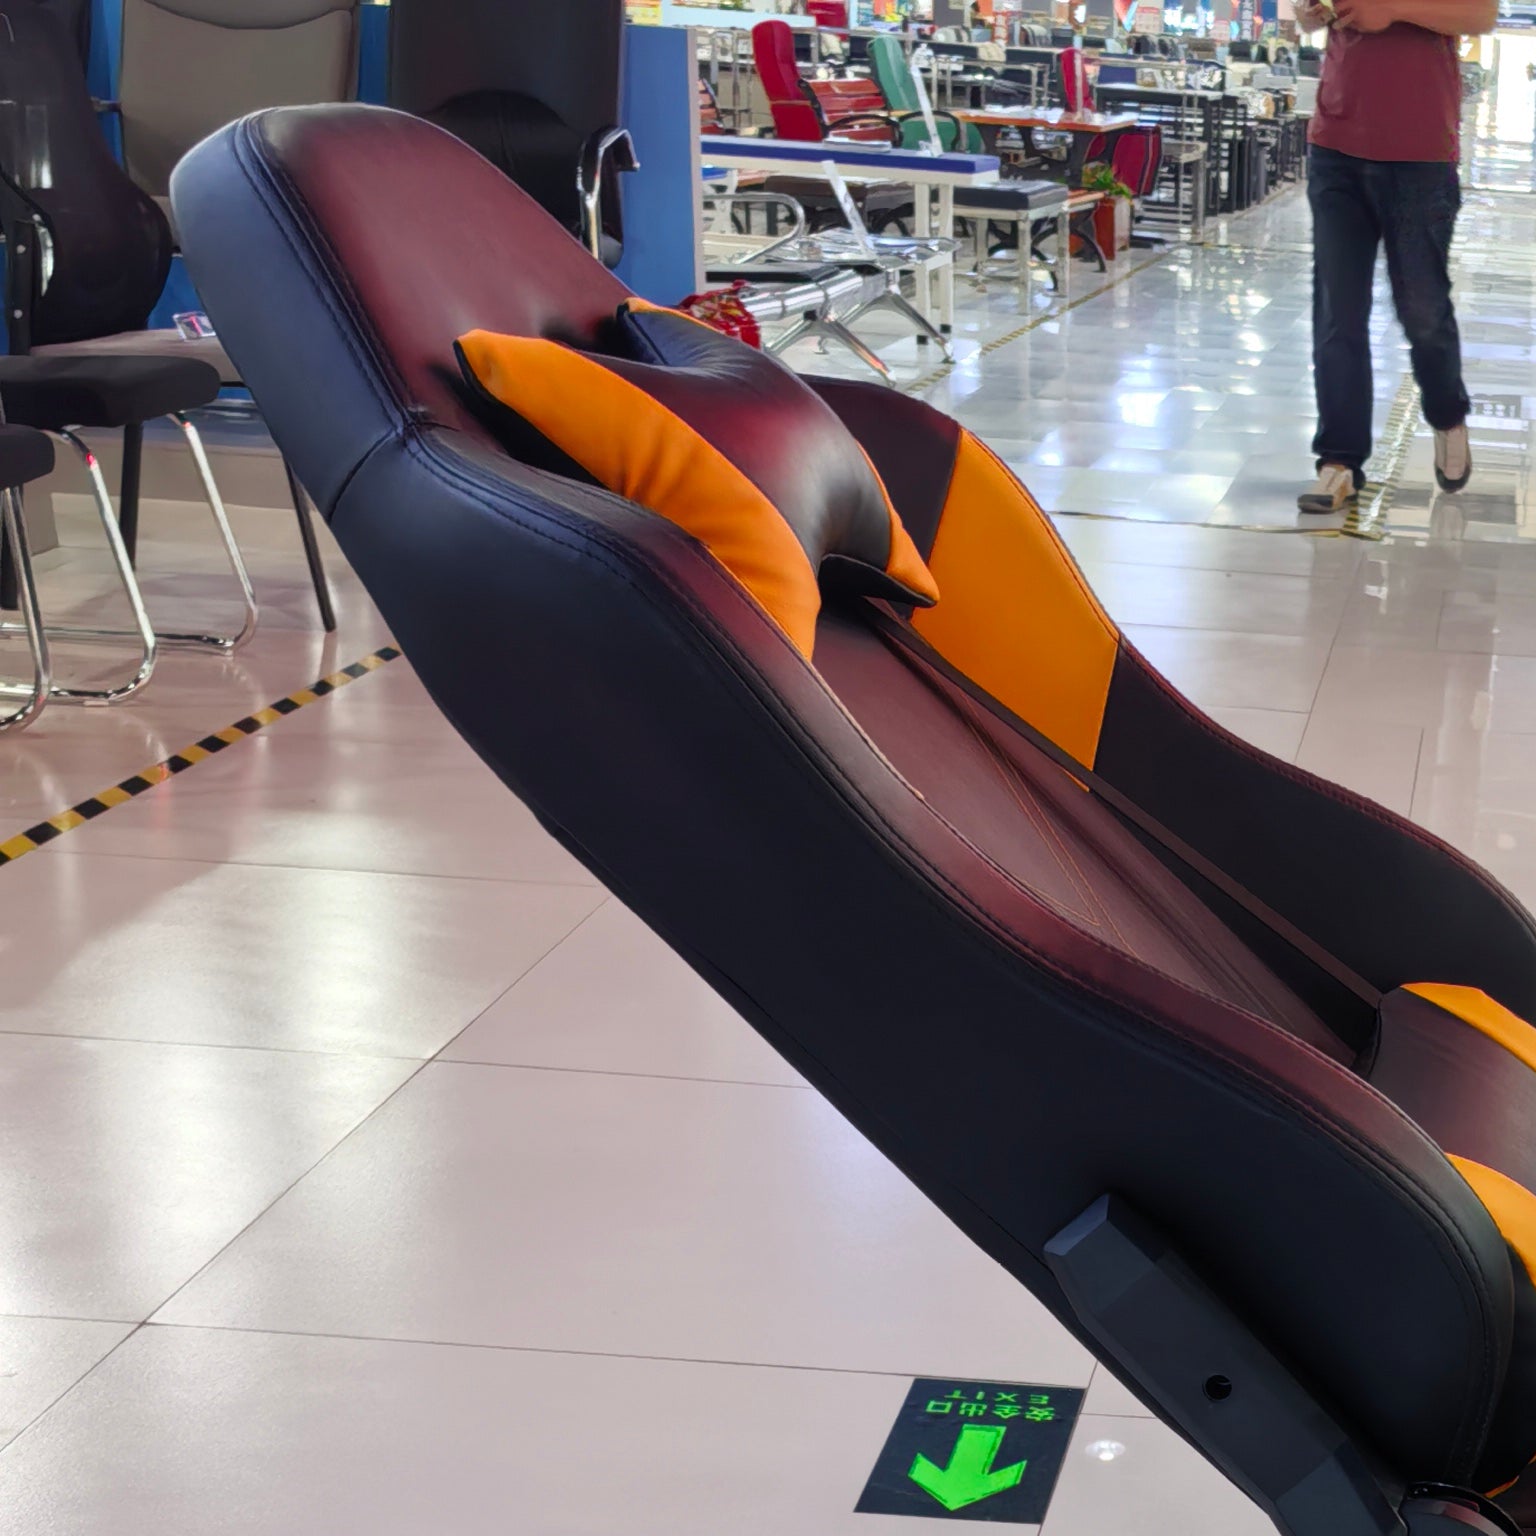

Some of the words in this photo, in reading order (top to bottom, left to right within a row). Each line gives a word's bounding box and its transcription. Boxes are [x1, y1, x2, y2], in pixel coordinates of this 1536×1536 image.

[945, 1390, 1050, 1404] EXIT
[926, 1400, 1055, 1421] 安全出口
